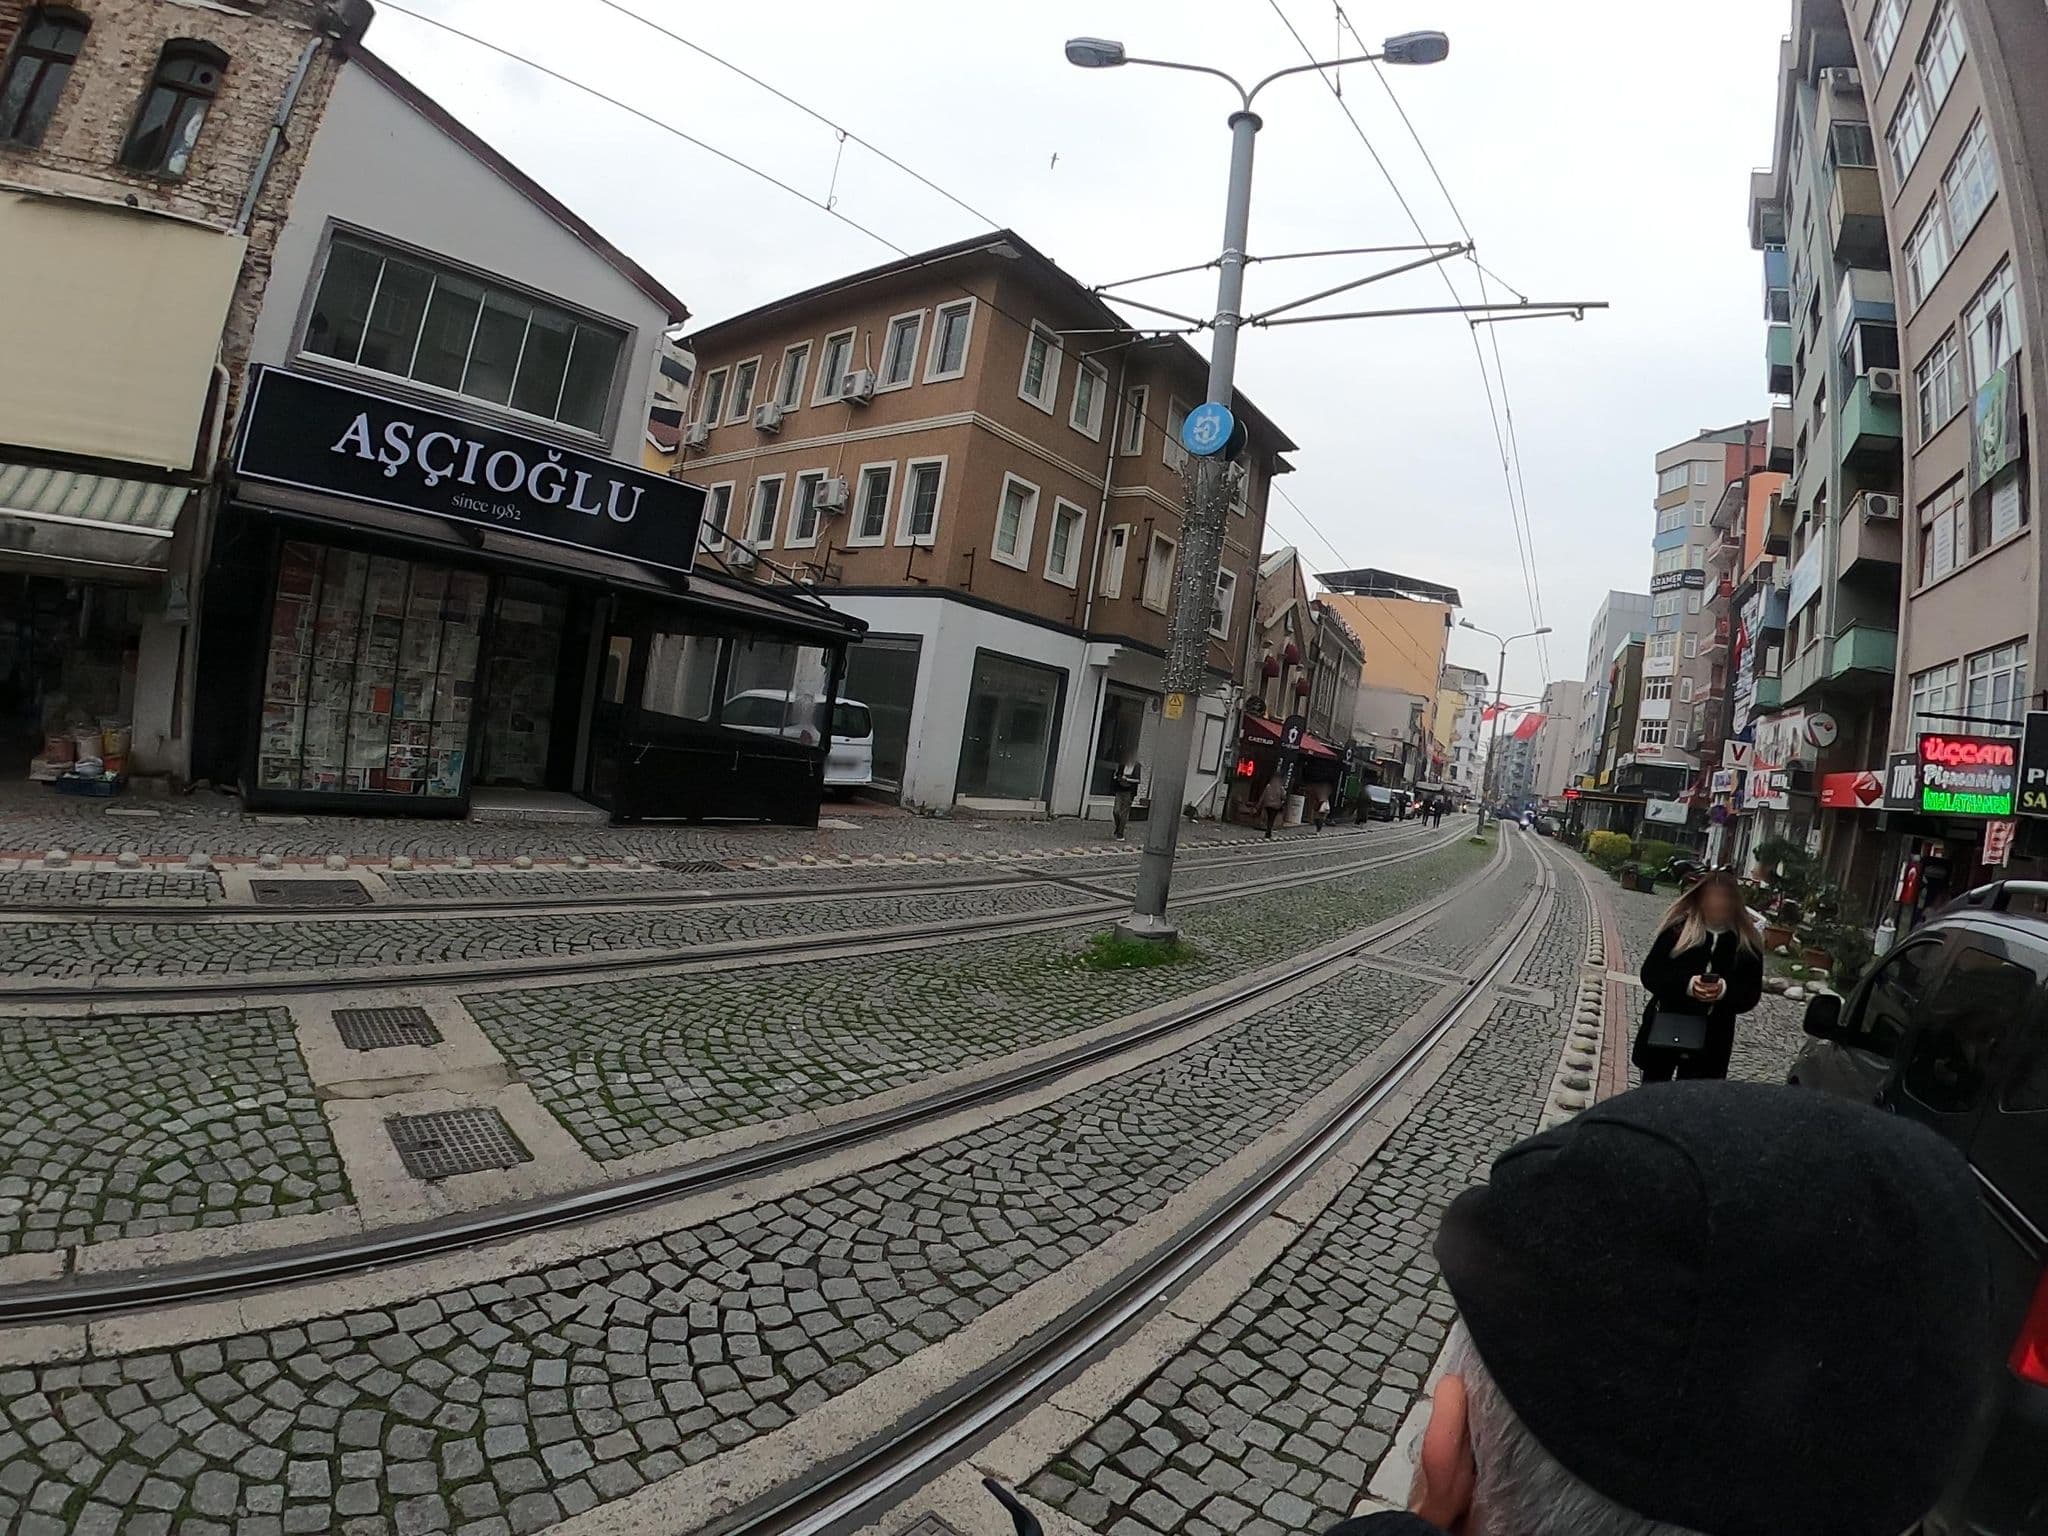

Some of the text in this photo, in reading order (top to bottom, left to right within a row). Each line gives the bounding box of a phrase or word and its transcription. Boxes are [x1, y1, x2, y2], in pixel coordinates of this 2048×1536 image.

[330, 411, 646, 523] AŞÇIOĞLU
[451, 492, 522, 521] since 1982
[1732, 743, 1747, 761] V
